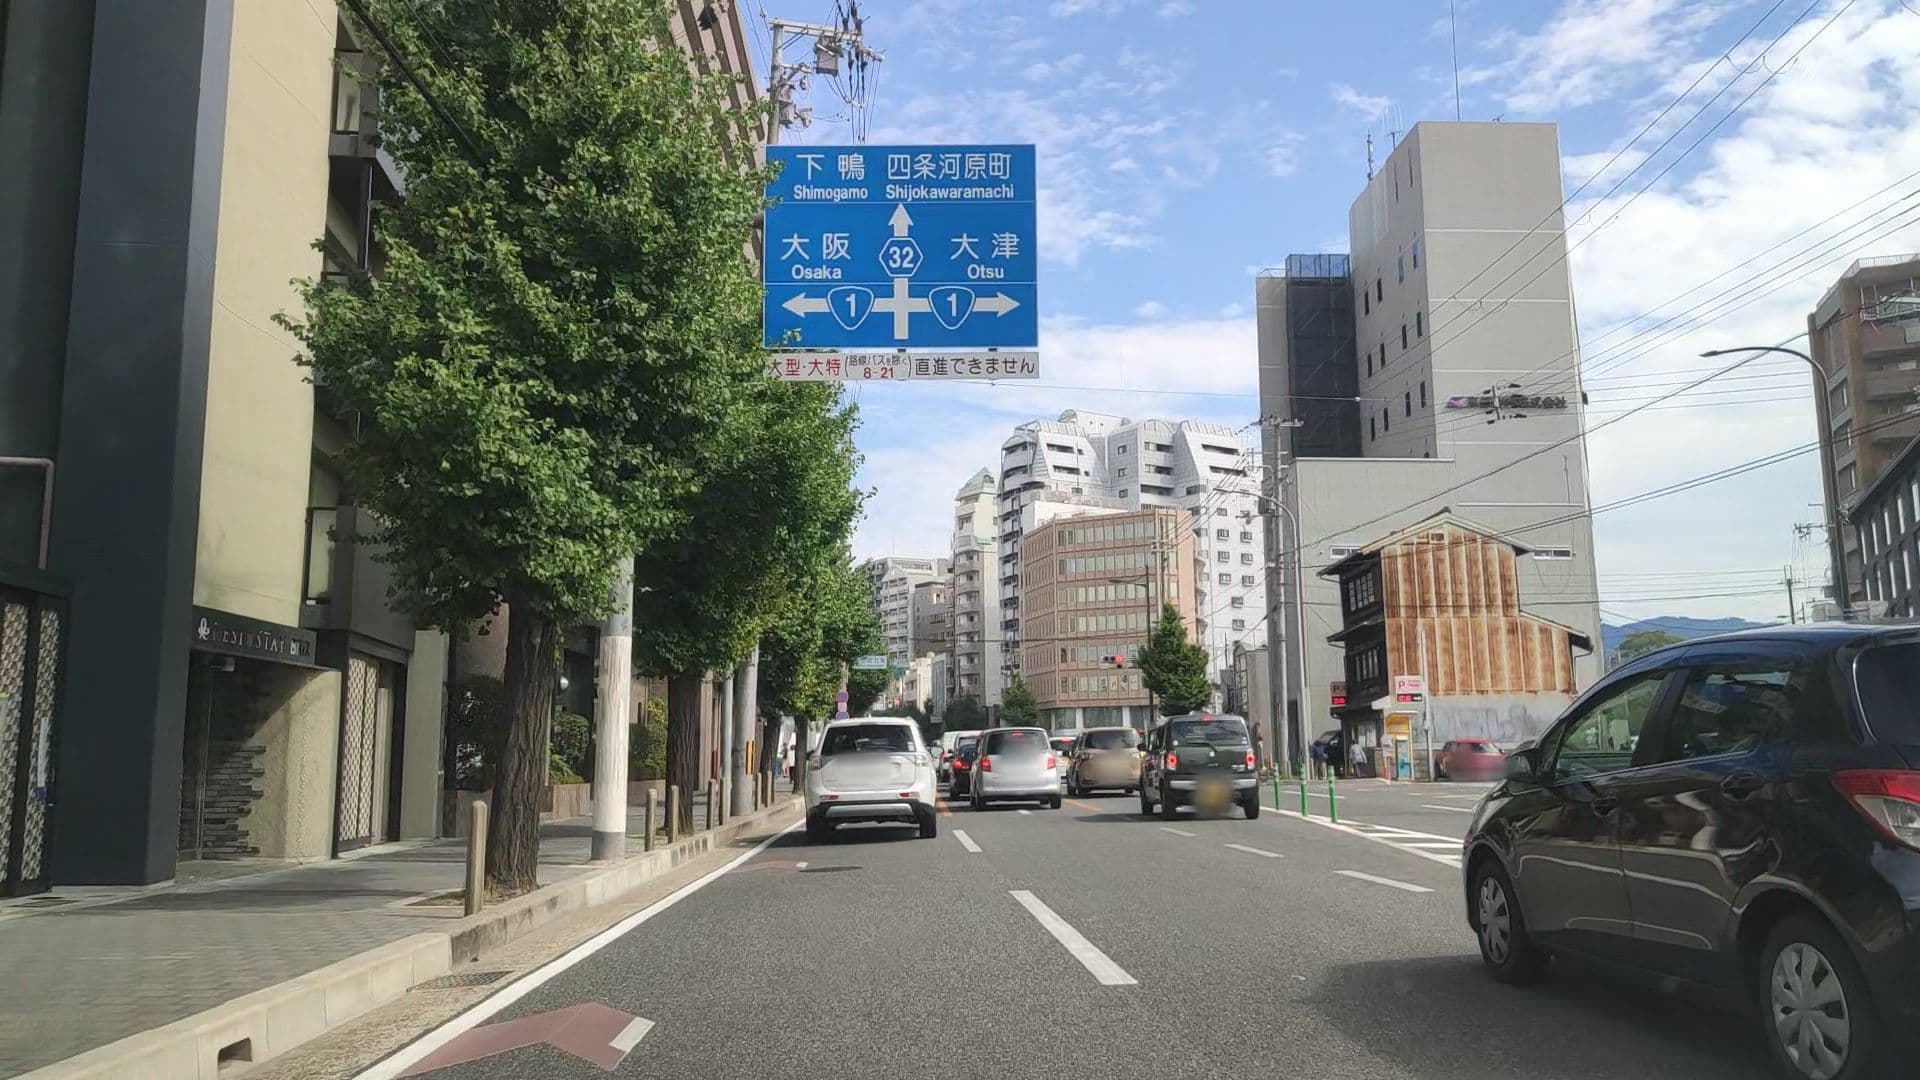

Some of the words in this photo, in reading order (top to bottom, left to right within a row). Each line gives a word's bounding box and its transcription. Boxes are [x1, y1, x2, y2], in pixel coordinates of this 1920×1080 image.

[796, 153, 866, 181] 下鴨
[888, 153, 1012, 180] 四条河原町
[793, 184, 868, 201] Shimogamo
[885, 184, 1014, 201] Shijokawaramachi
[780, 233, 852, 260] 大阪
[888, 246, 914, 268] 32
[950, 232, 1020, 260] 大津
[791, 264, 842, 279] Osaka
[967, 263, 1004, 279] Otsu
[845, 293, 856, 318] 1
[946, 293, 957, 317] 1
[915, 356, 1035, 376] 直進できません
